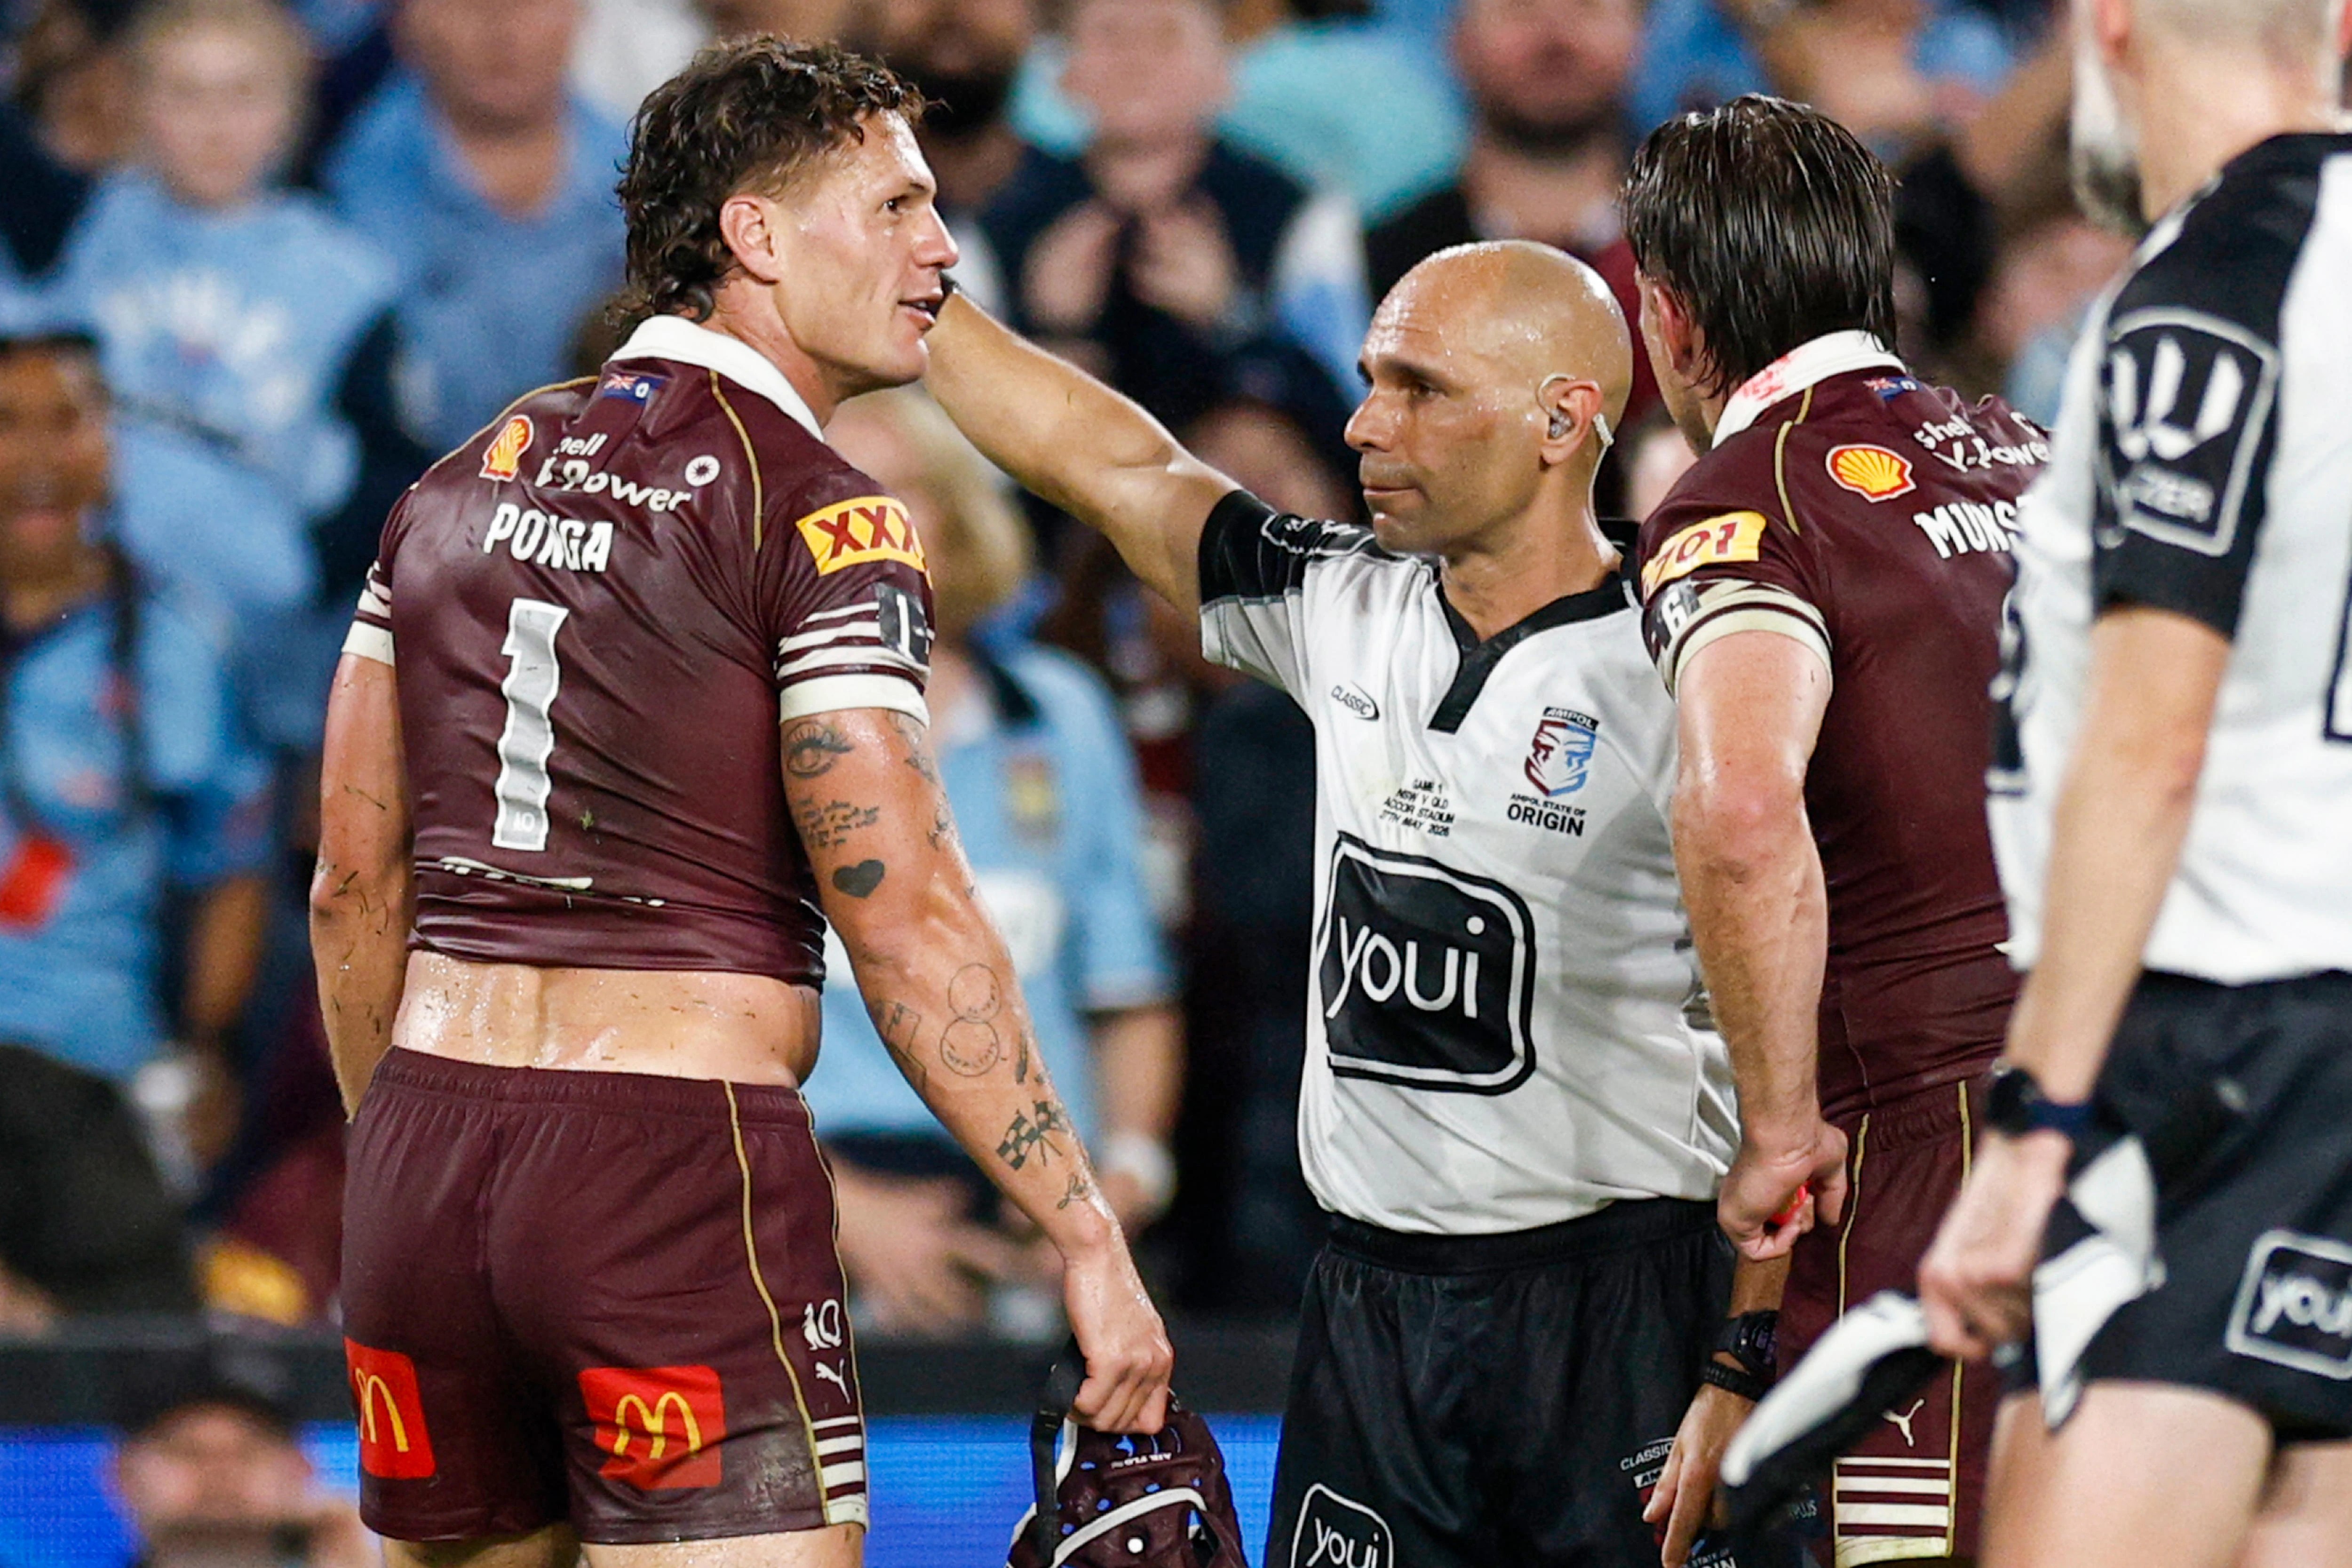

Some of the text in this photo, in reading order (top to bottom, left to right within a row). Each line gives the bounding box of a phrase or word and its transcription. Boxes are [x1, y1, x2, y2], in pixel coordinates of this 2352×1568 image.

[1932, 438, 2051, 473] V-Powe
[483, 502, 614, 572] PONGA
[1913, 495, 2035, 558] MUNS
[1331, 685, 1371, 716] CLASSIC
[492, 597, 569, 852] 1
[1546, 707, 1595, 729] AMPOL
[1384, 796, 1455, 823] ACCOR STADIUM
[1431, 796, 1449, 809] QLD
[1510, 793, 1587, 817] AMPOL STATE OF
[1507, 803, 1585, 837] ORIGIN
[1326, 915, 1486, 1019] youi
[1305, 1516, 1379, 1568] youi
